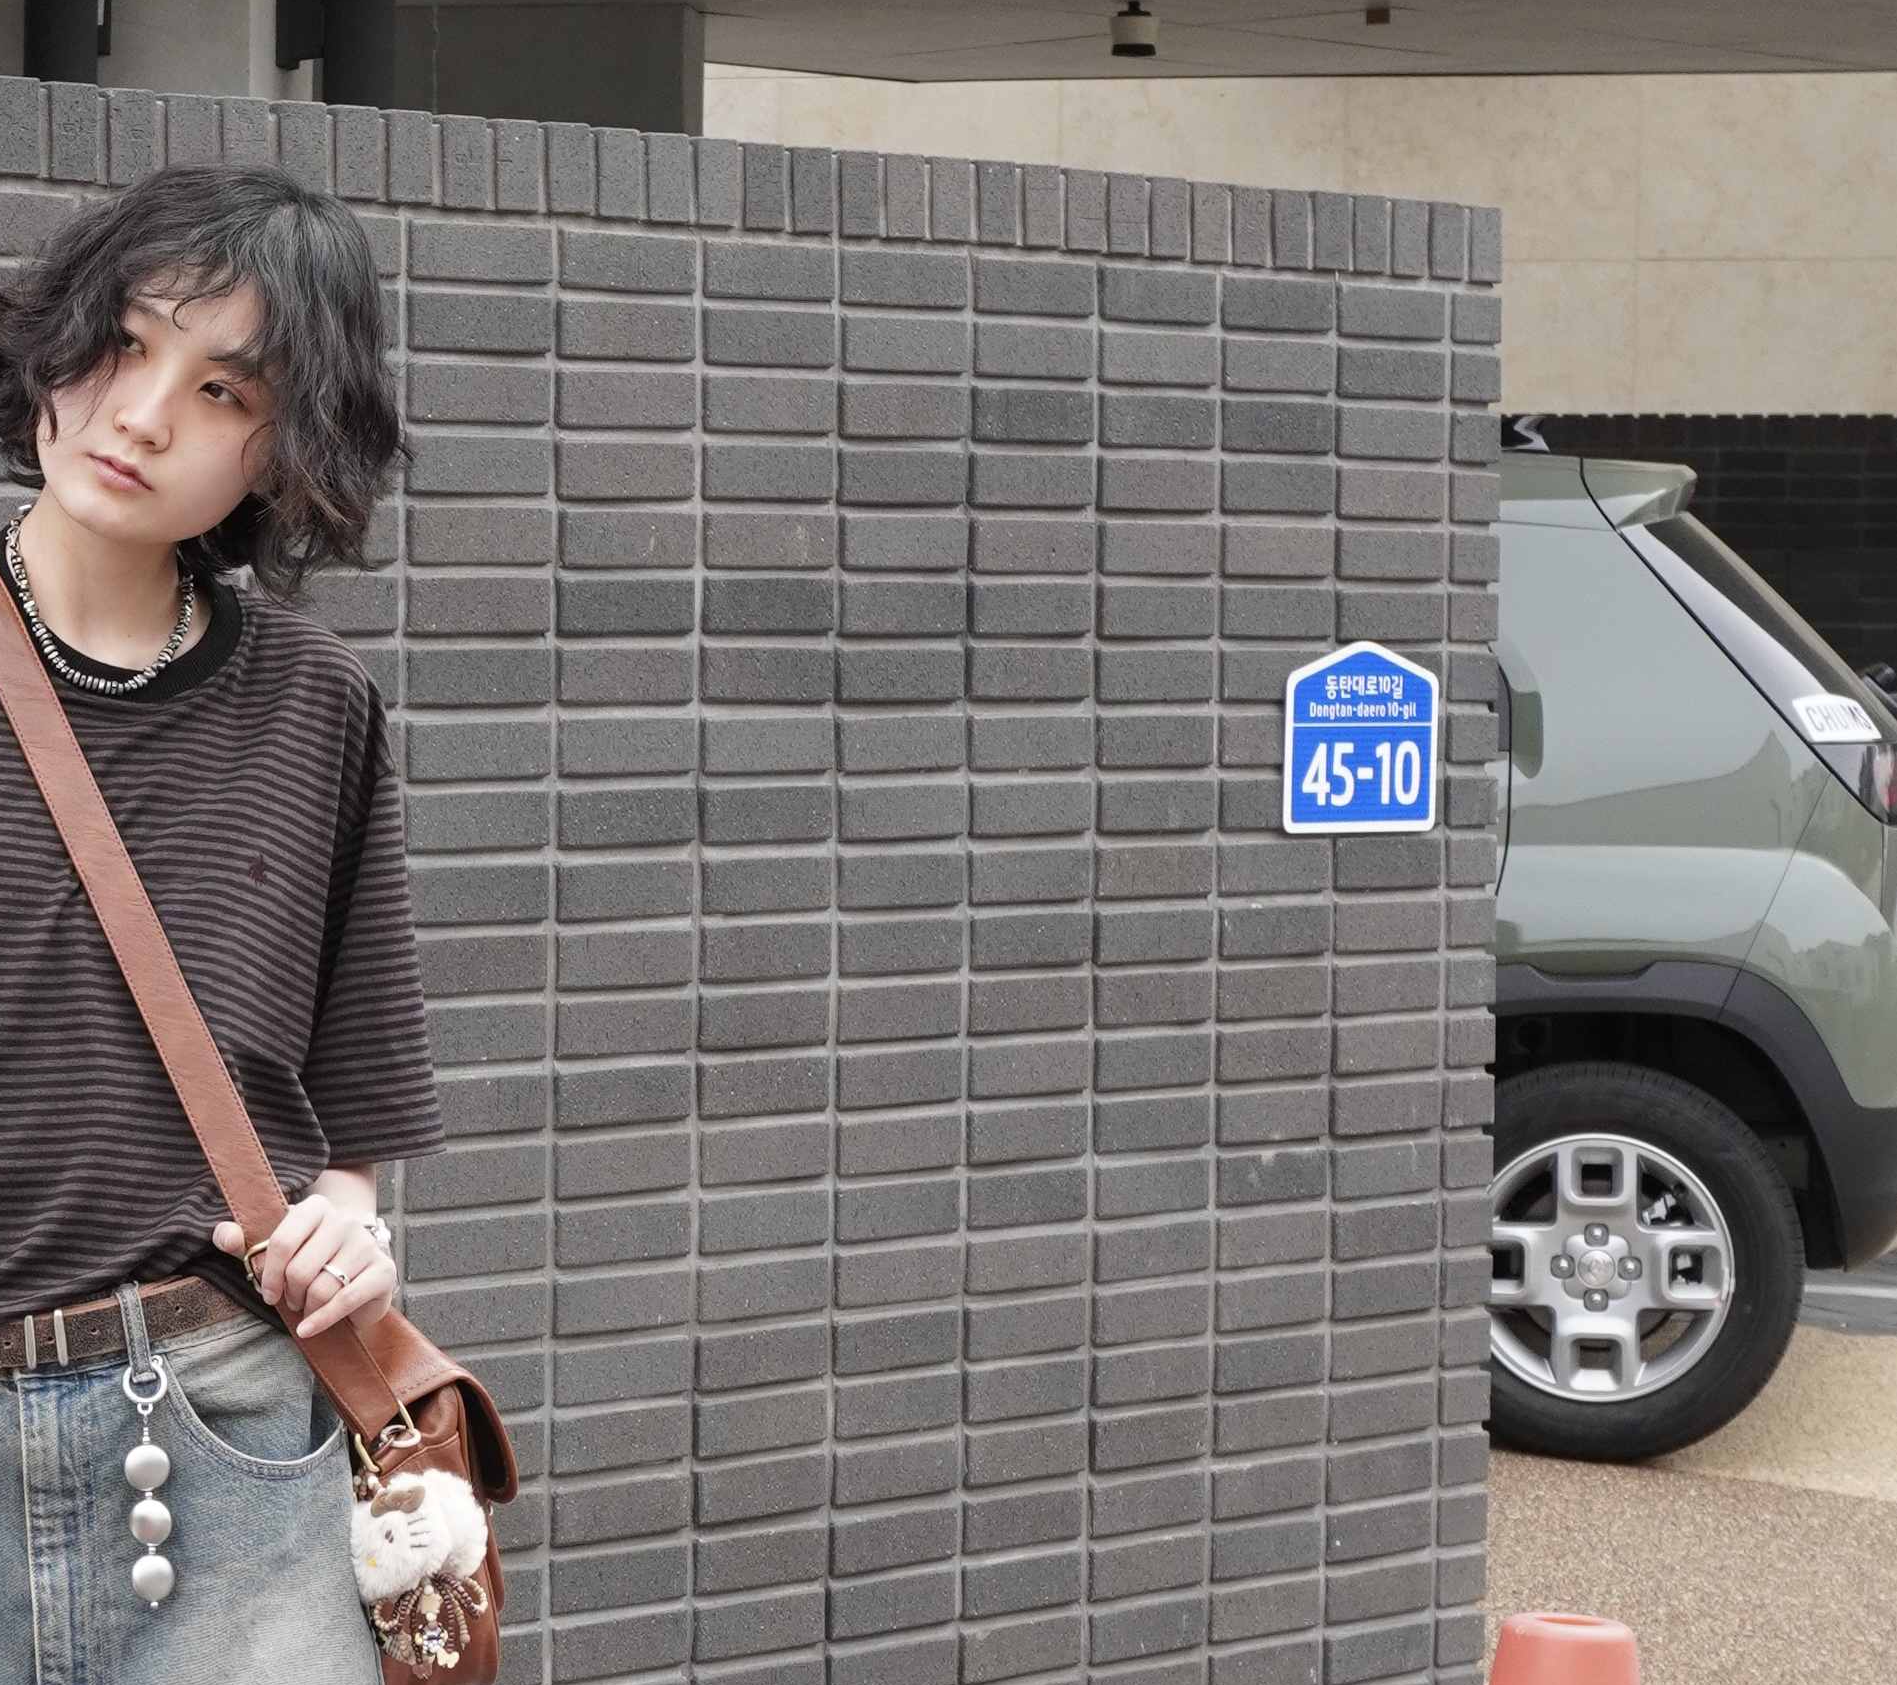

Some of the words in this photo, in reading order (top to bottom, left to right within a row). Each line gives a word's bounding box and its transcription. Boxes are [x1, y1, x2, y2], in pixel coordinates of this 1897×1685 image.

[1325, 675, 1403, 699] 동탄대로10길
[1309, 702, 1386, 720] Dongtan-daero
[1387, 702, 1417, 720] 10-gil
[1806, 705, 1873, 731] CHUMS
[1302, 741, 1421, 806] 45-10
